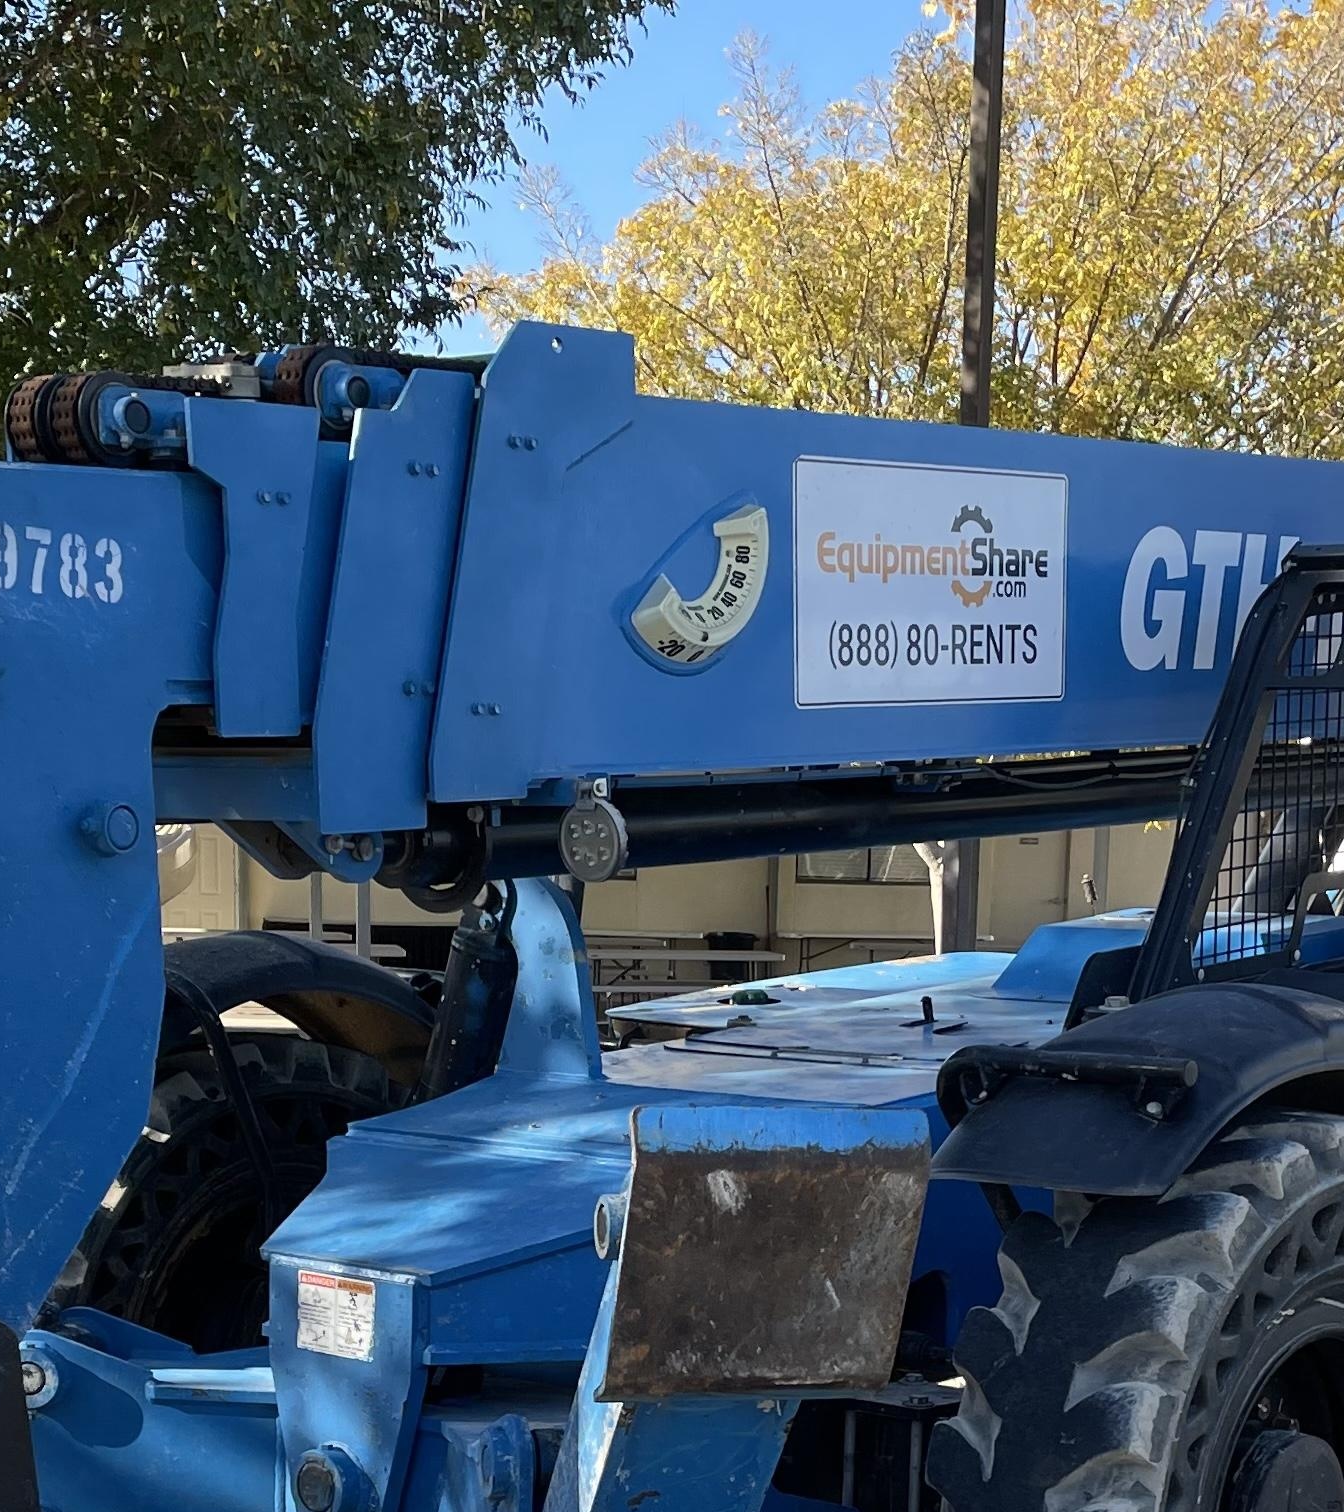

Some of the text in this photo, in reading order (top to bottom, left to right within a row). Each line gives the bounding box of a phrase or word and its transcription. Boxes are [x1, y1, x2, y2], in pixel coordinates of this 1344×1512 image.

[735, 545, 751, 565] 80
[816, 531, 1049, 584] EquipmentShare
[729, 570, 747, 589] 60
[720, 591, 738, 608] 40
[707, 605, 725, 621] 20
[829, 619, 1038, 670] (888) 80-RENTS
